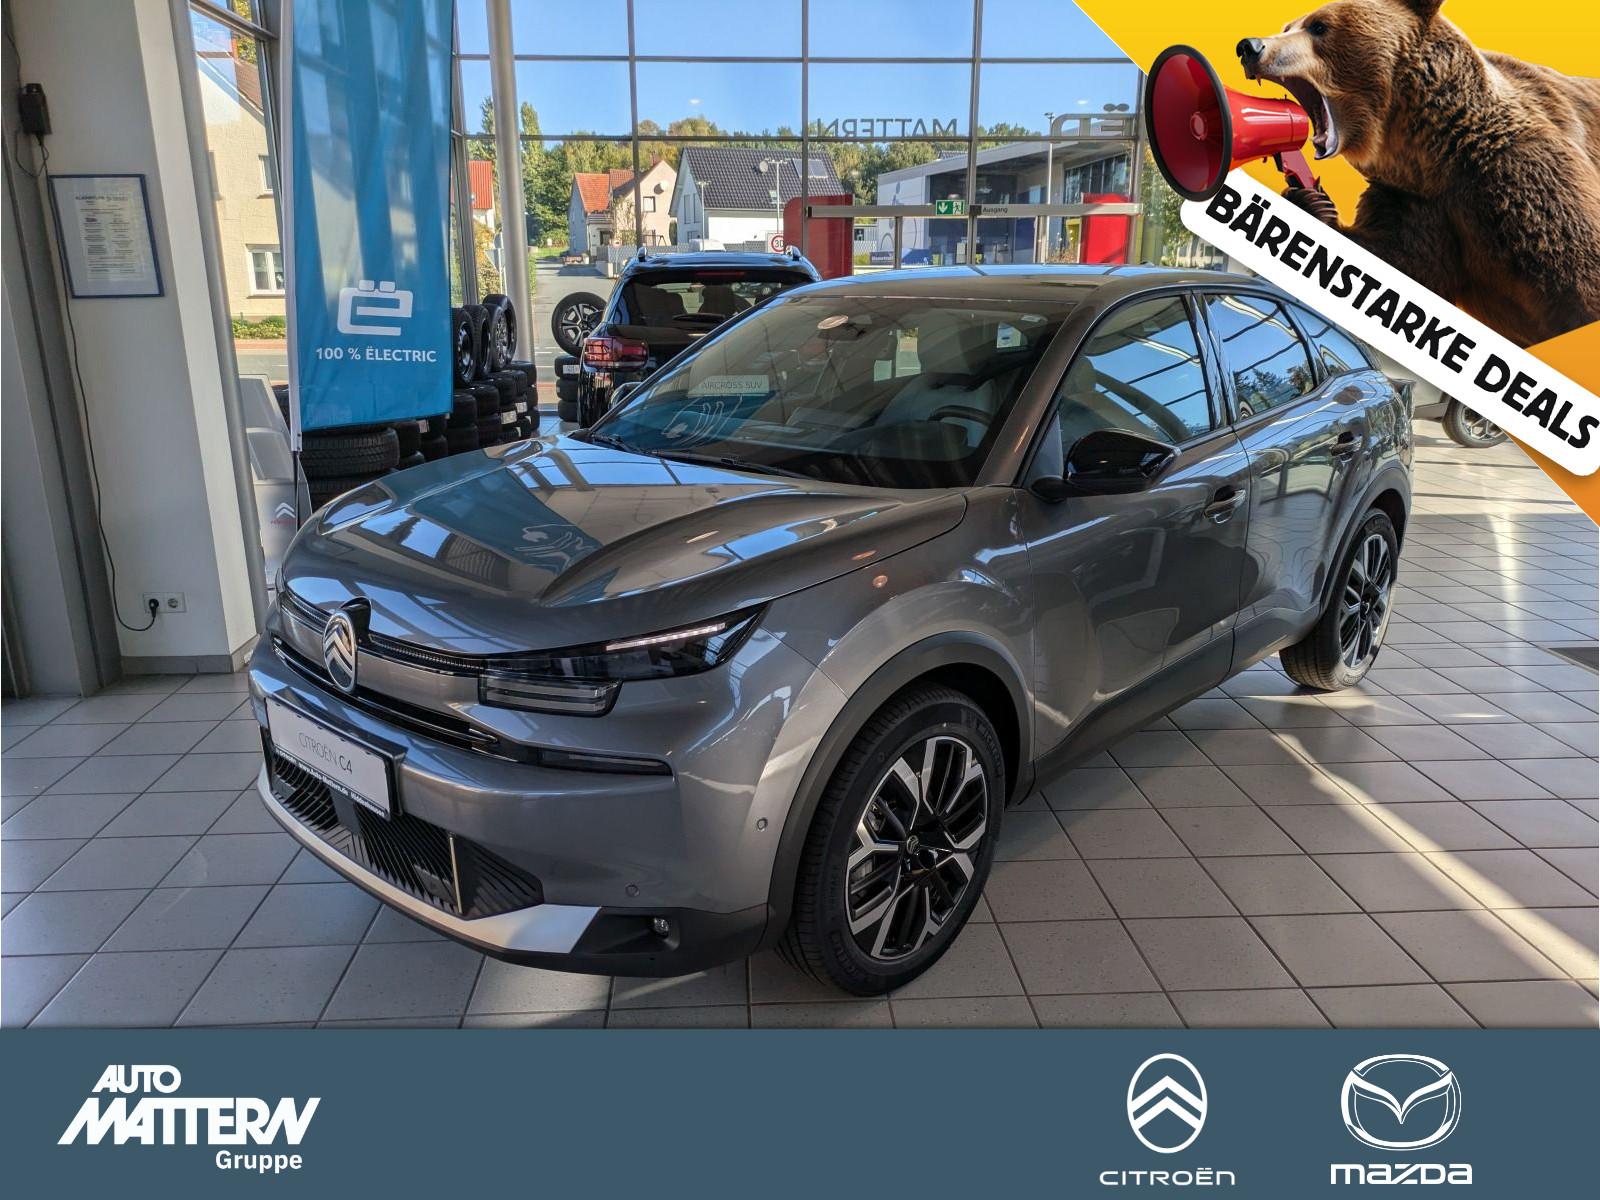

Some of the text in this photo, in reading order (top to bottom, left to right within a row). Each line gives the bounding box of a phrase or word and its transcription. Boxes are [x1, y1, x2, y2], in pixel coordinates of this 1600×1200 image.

[983, 206, 1008, 214] Ausgang
[316, 345, 437, 362] 100 % ËLECTRIC
[703, 381, 763, 390] AIRCROSS SUV
[299, 732, 338, 766] CITROËN
[339, 755, 353, 774] C4
